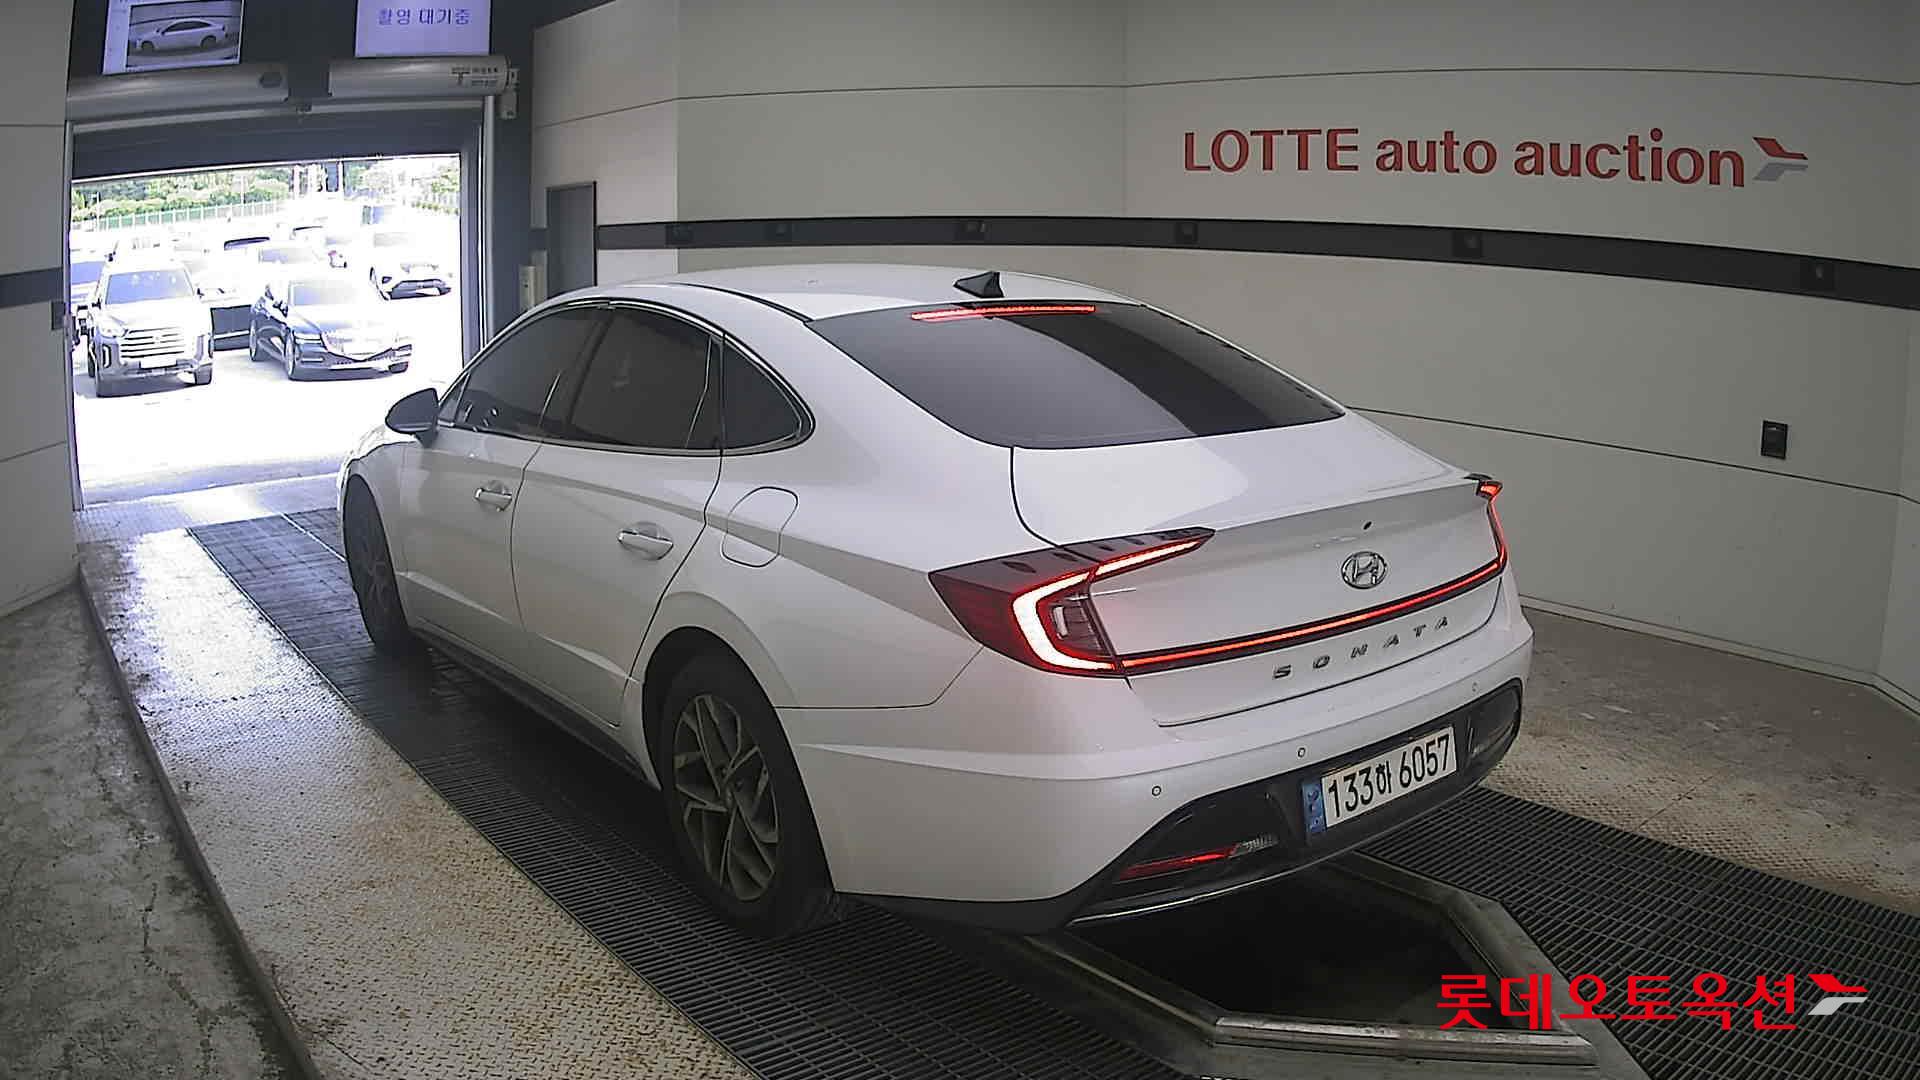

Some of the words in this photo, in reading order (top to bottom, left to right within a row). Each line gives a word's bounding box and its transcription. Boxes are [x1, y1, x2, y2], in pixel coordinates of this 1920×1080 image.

[419, 8, 470, 25] 대기중
[1184, 128, 1359, 172] LOTTE
[1376, 130, 1497, 174] auto
[1514, 128, 1745, 188] auction
[1273, 616, 1448, 679] SONATA
[1328, 760, 1393, 818] 133하
[1399, 734, 1450, 788] 6057
